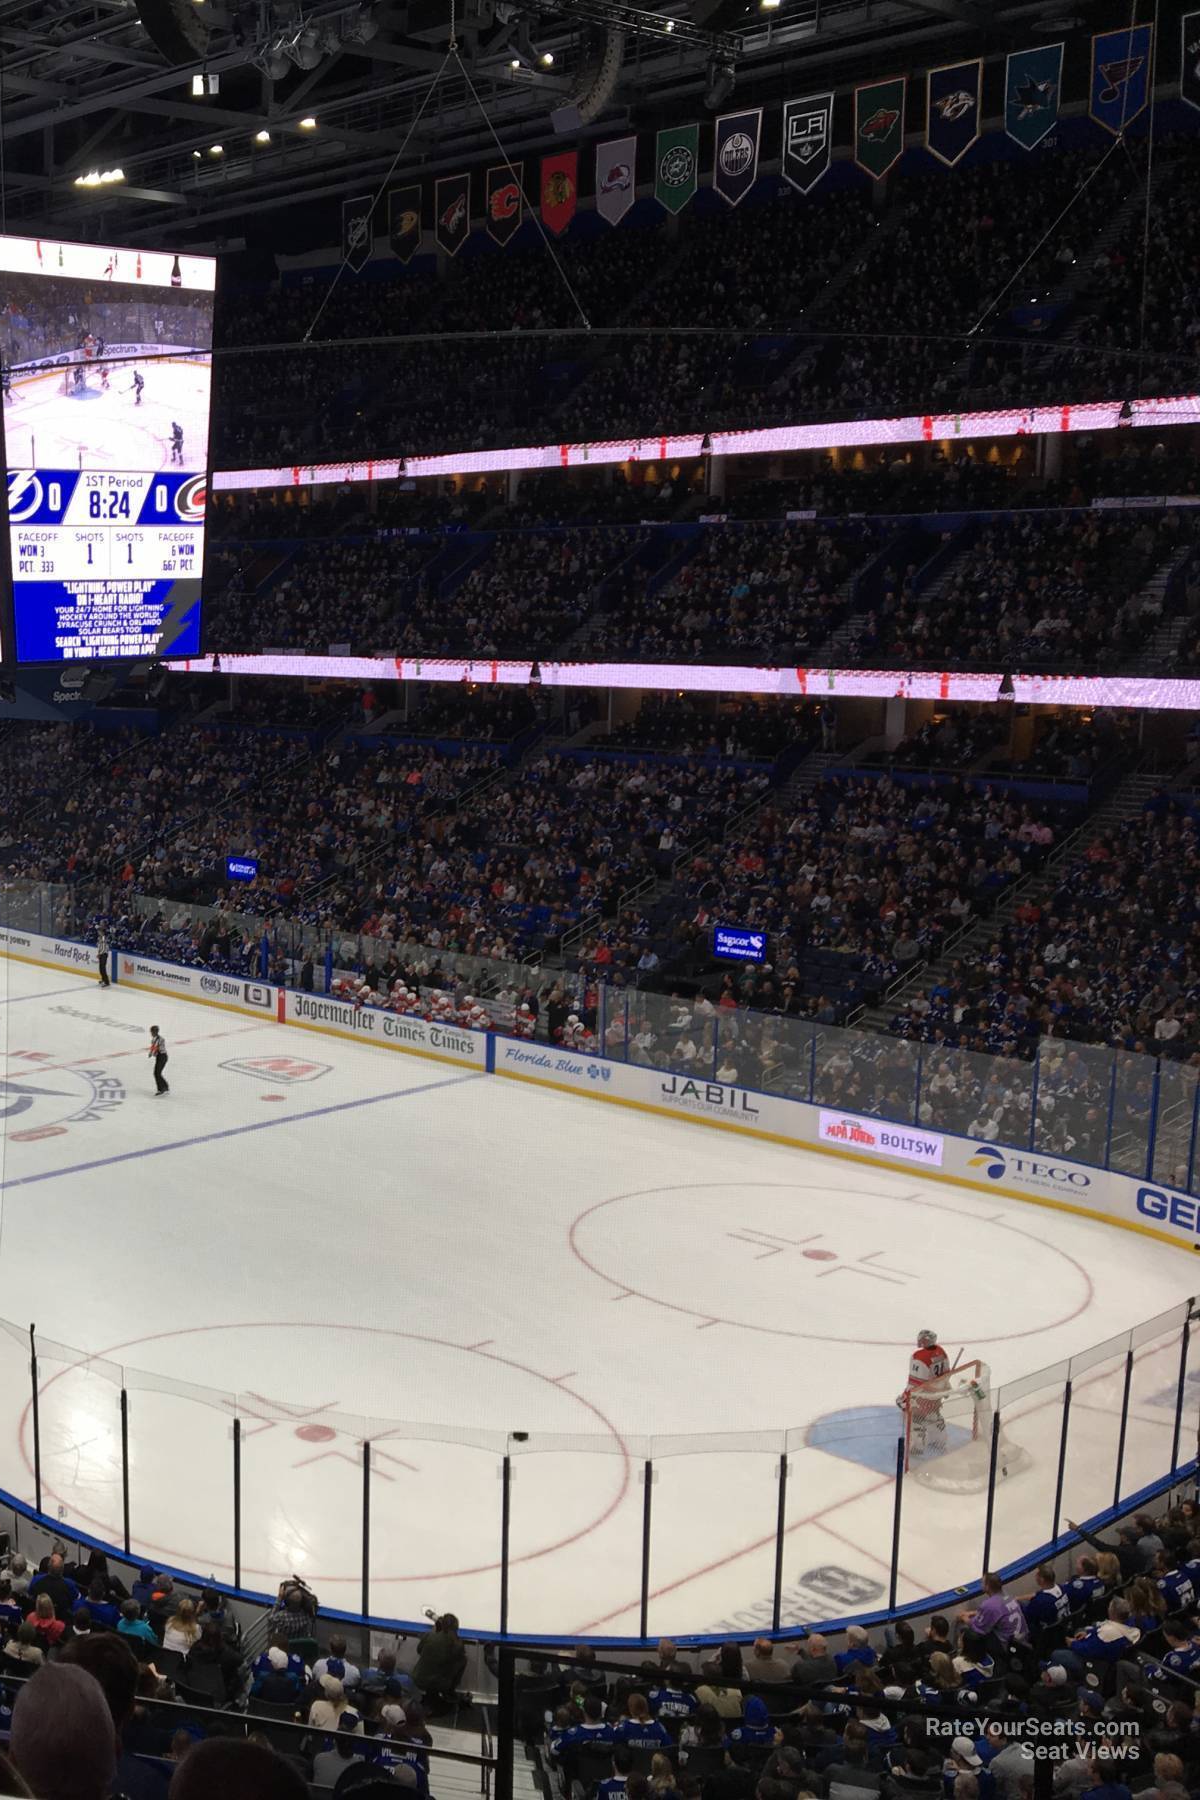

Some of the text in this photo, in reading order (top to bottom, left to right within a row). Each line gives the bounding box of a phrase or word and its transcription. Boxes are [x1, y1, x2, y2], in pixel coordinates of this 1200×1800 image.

[792, 115, 824, 137] LA
[86, 476, 143, 488] 1ST Period
[49, 482, 61, 511] 0
[89, 490, 130, 518] 8:24
[155, 484, 167, 512] 0
[18, 532, 59, 542] FACEOFF
[75, 532, 104, 542] SHOTS
[115, 532, 144, 542] SHOTS
[158, 532, 195, 542] FACEOFF
[19, 545, 38, 557] WON
[87, 543, 93, 564] 1
[127, 543, 133, 564] 1
[178, 544, 194, 555] WON
[106, 581, 132, 592] POWER
[133, 580, 156, 592] PLAY"
[54, 604, 164, 614] YOUR 24/7 HOME FOR LIGHTNING
[59, 613, 87, 621] HOCKEY
[89, 613, 118, 621] AROUND
[133, 611, 160, 619] WORLD!
[57, 620, 92, 628] SYRACUSE
[129, 618, 161, 626] ORLANDO
[120, 634, 142, 645] POWER
[54, 943, 91, 965] Hard Rock
[136, 963, 191, 984] MicroLumen
[222, 982, 240, 996] SUN
[383, 1015, 425, 1043] Times
[430, 1027, 475, 1055] Times
[505, 1047, 583, 1076] Florida Blue
[67, 1068, 127, 1124] ARENA
[662, 1077, 759, 1113] JABIL
[880, 1132, 938, 1156] BOLTSW
[1011, 1157, 1091, 1188] TECO
